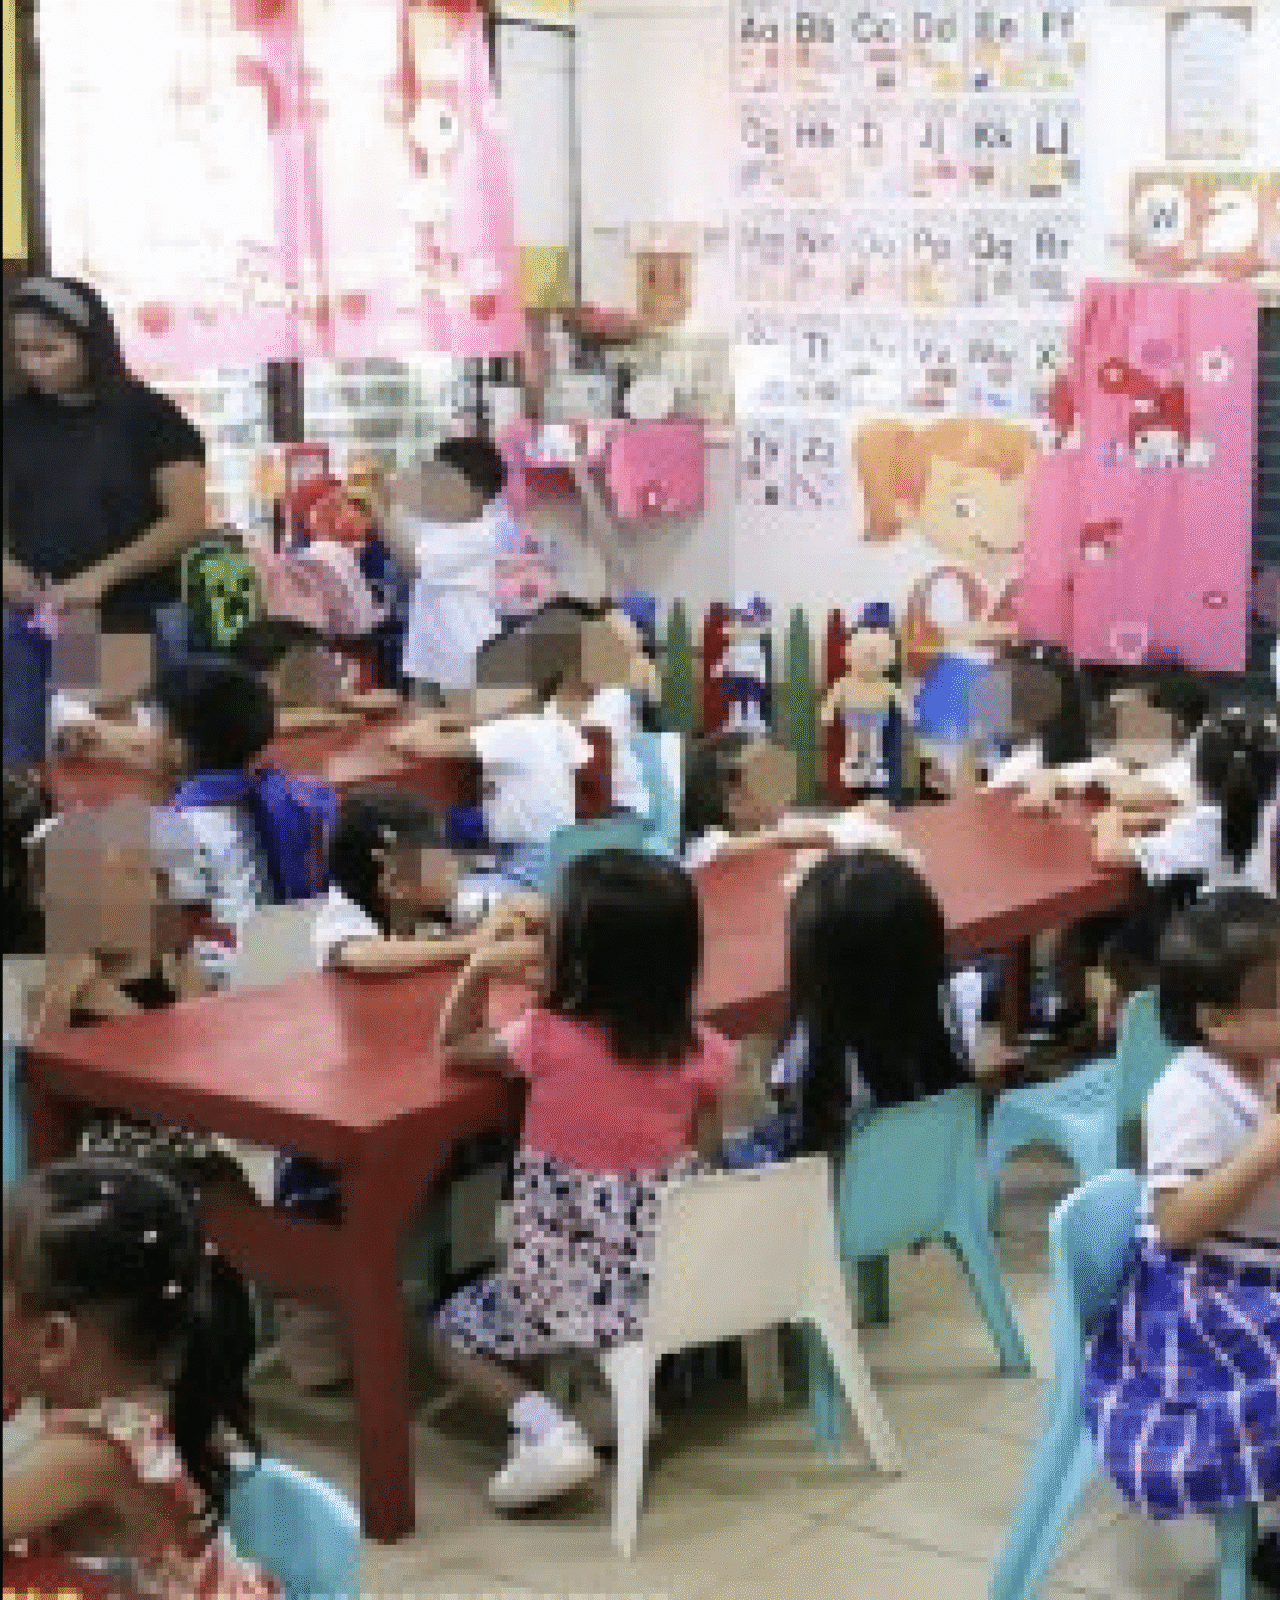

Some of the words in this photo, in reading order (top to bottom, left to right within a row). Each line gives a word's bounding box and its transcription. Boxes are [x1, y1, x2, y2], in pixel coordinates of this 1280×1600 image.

[741, 18, 778, 43] Aa
[796, 12, 834, 43] Bb
[851, 12, 896, 43] Cc
[913, 12, 956, 43] Dd
